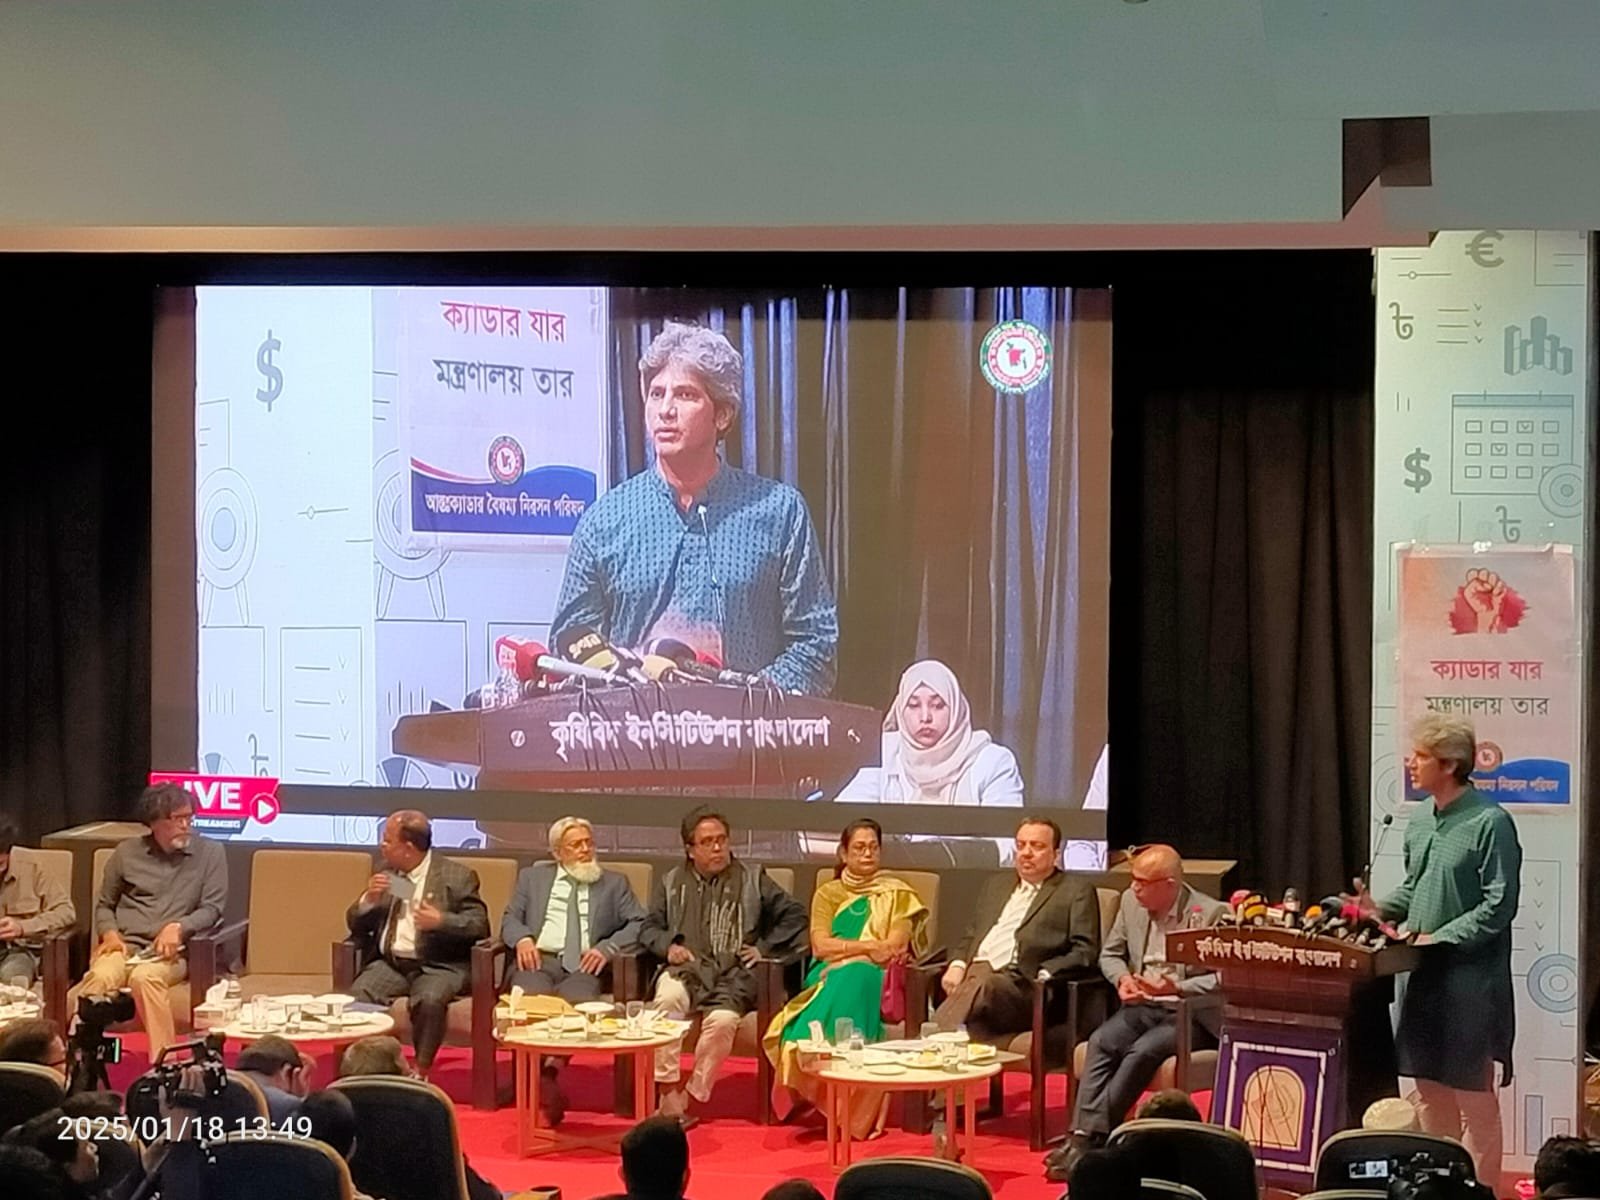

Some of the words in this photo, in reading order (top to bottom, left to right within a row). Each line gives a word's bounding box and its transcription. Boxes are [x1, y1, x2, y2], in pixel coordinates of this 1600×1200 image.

[440, 301, 521, 338] ক্যাডার
[528, 310, 567, 343] যার
[432, 358, 525, 395] মন্ত্রণালয়
[532, 367, 575, 399] তার
[1431, 660, 1500, 681] ক্যাডার
[1509, 660, 1544, 681] যার
[1424, 695, 1504, 716] মন্ত্রণালয়
[1510, 696, 1550, 716] তার
[183, 780, 242, 811] VE
